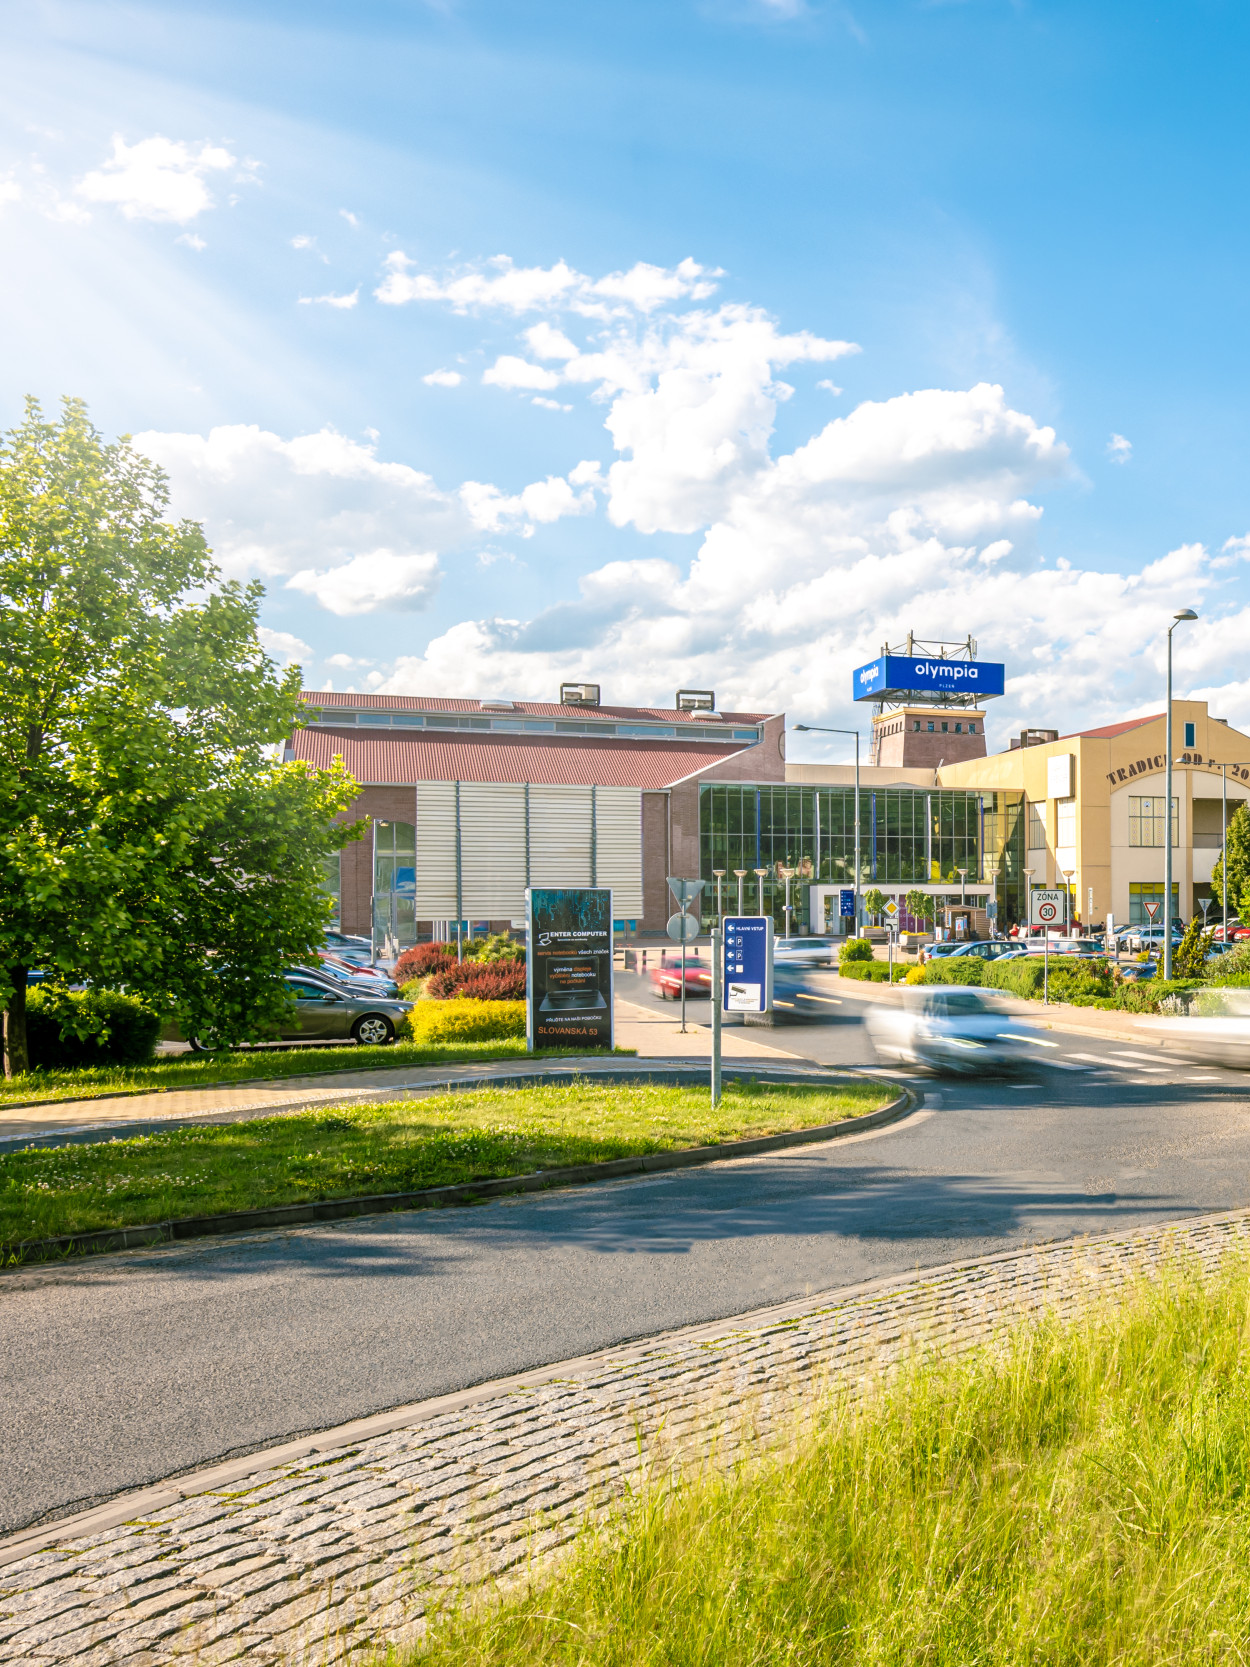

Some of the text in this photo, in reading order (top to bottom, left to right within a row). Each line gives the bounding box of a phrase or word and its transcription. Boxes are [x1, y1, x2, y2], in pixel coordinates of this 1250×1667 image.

[915, 662, 978, 680] olympia
[1037, 892, 1058, 900] ZÓNA
[1043, 908, 1053, 916] 30
[538, 1026, 598, 1036] SLOVANSKÁ 53
